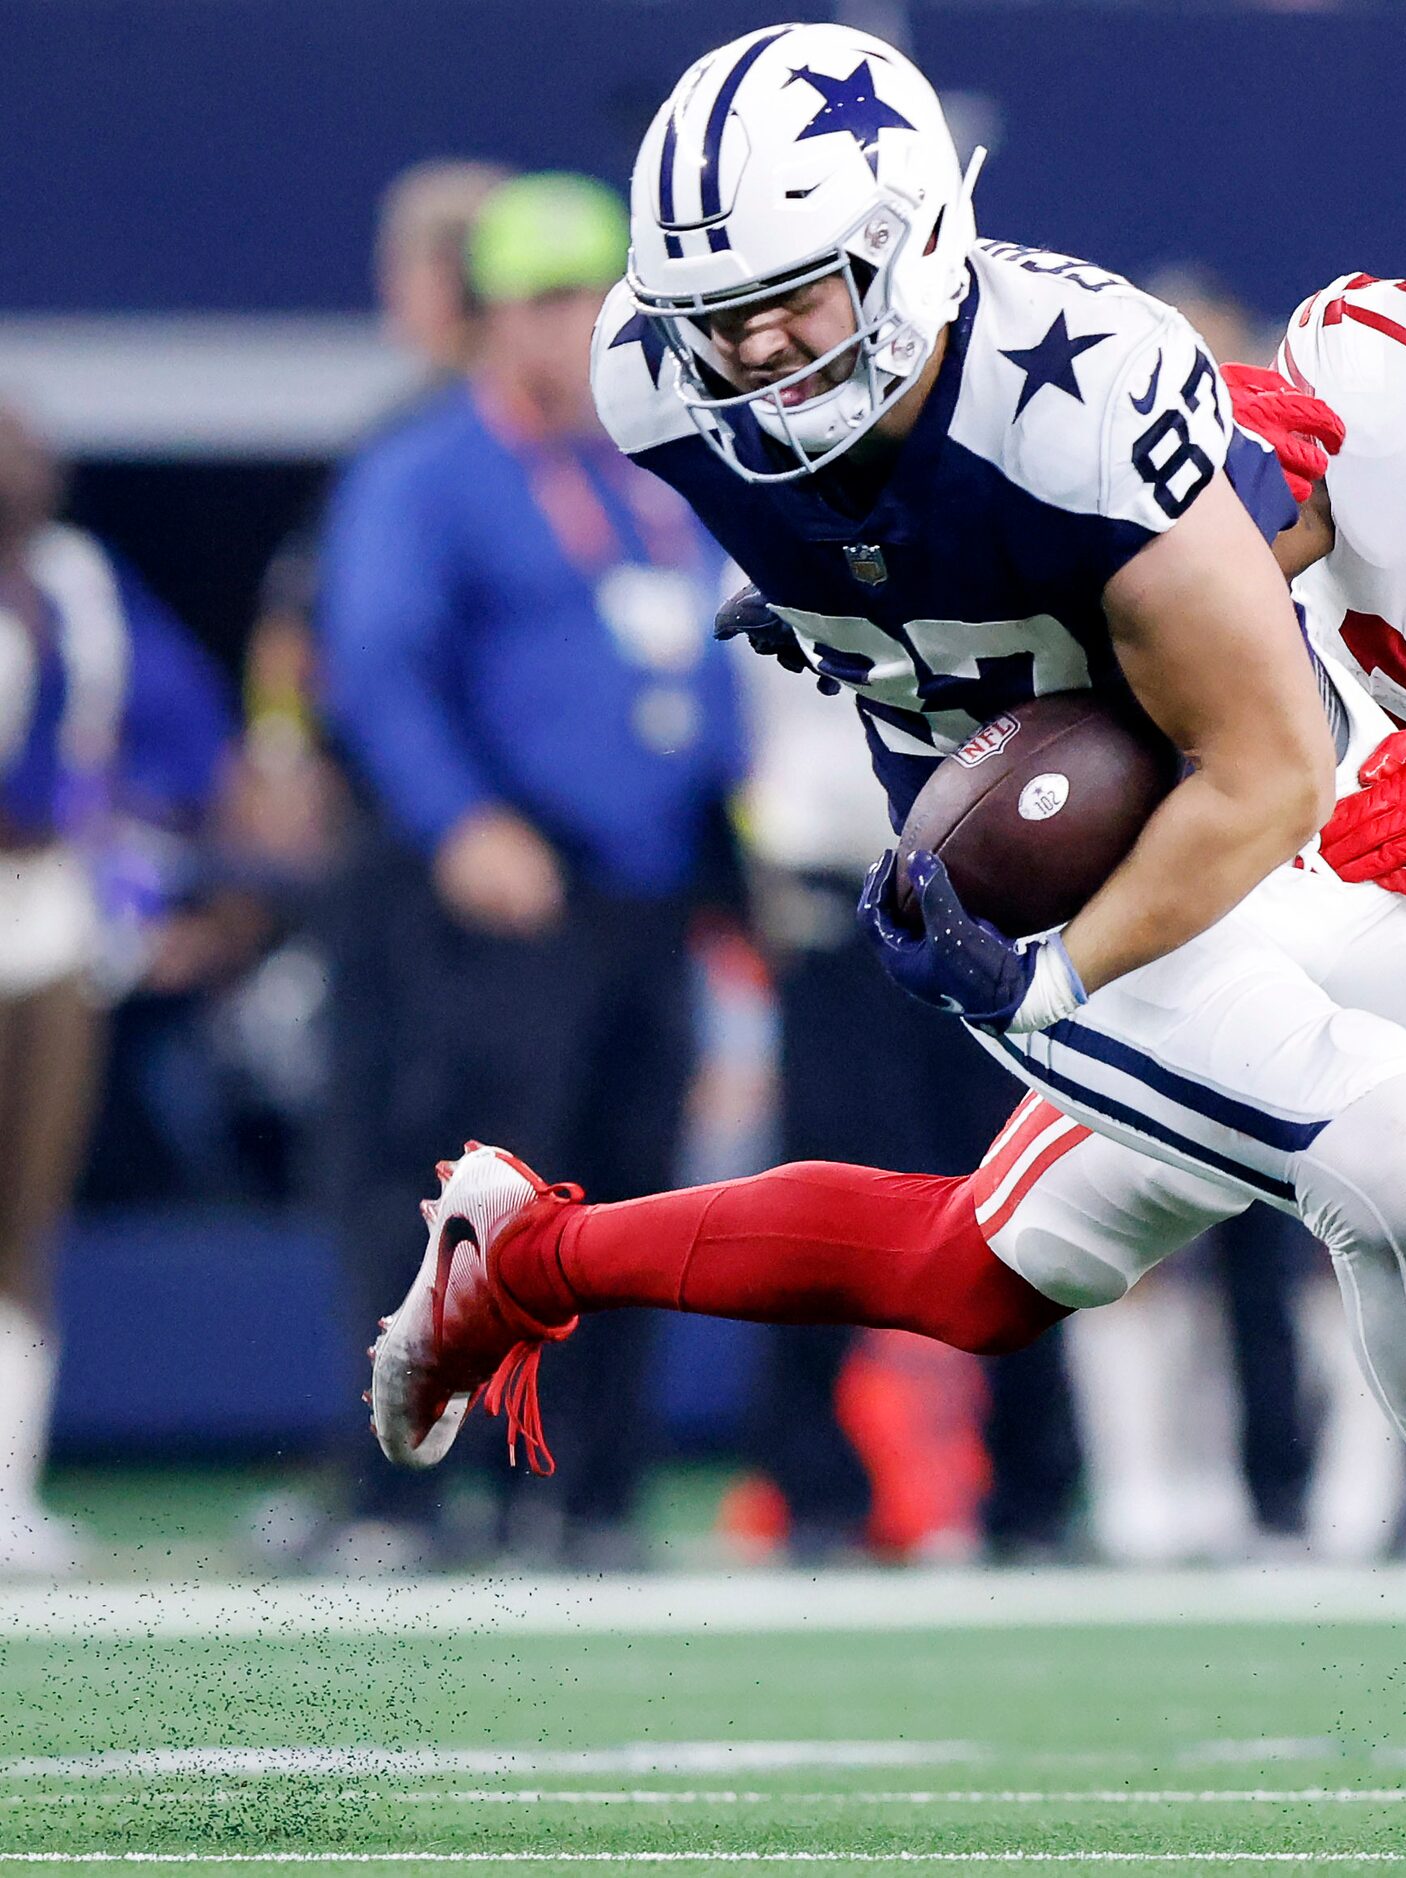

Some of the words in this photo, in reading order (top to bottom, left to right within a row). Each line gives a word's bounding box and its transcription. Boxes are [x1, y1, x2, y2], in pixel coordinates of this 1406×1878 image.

[1133, 345, 1225, 519] 87
[962, 722, 1012, 760] NFL
[1034, 791, 1062, 815] 102
